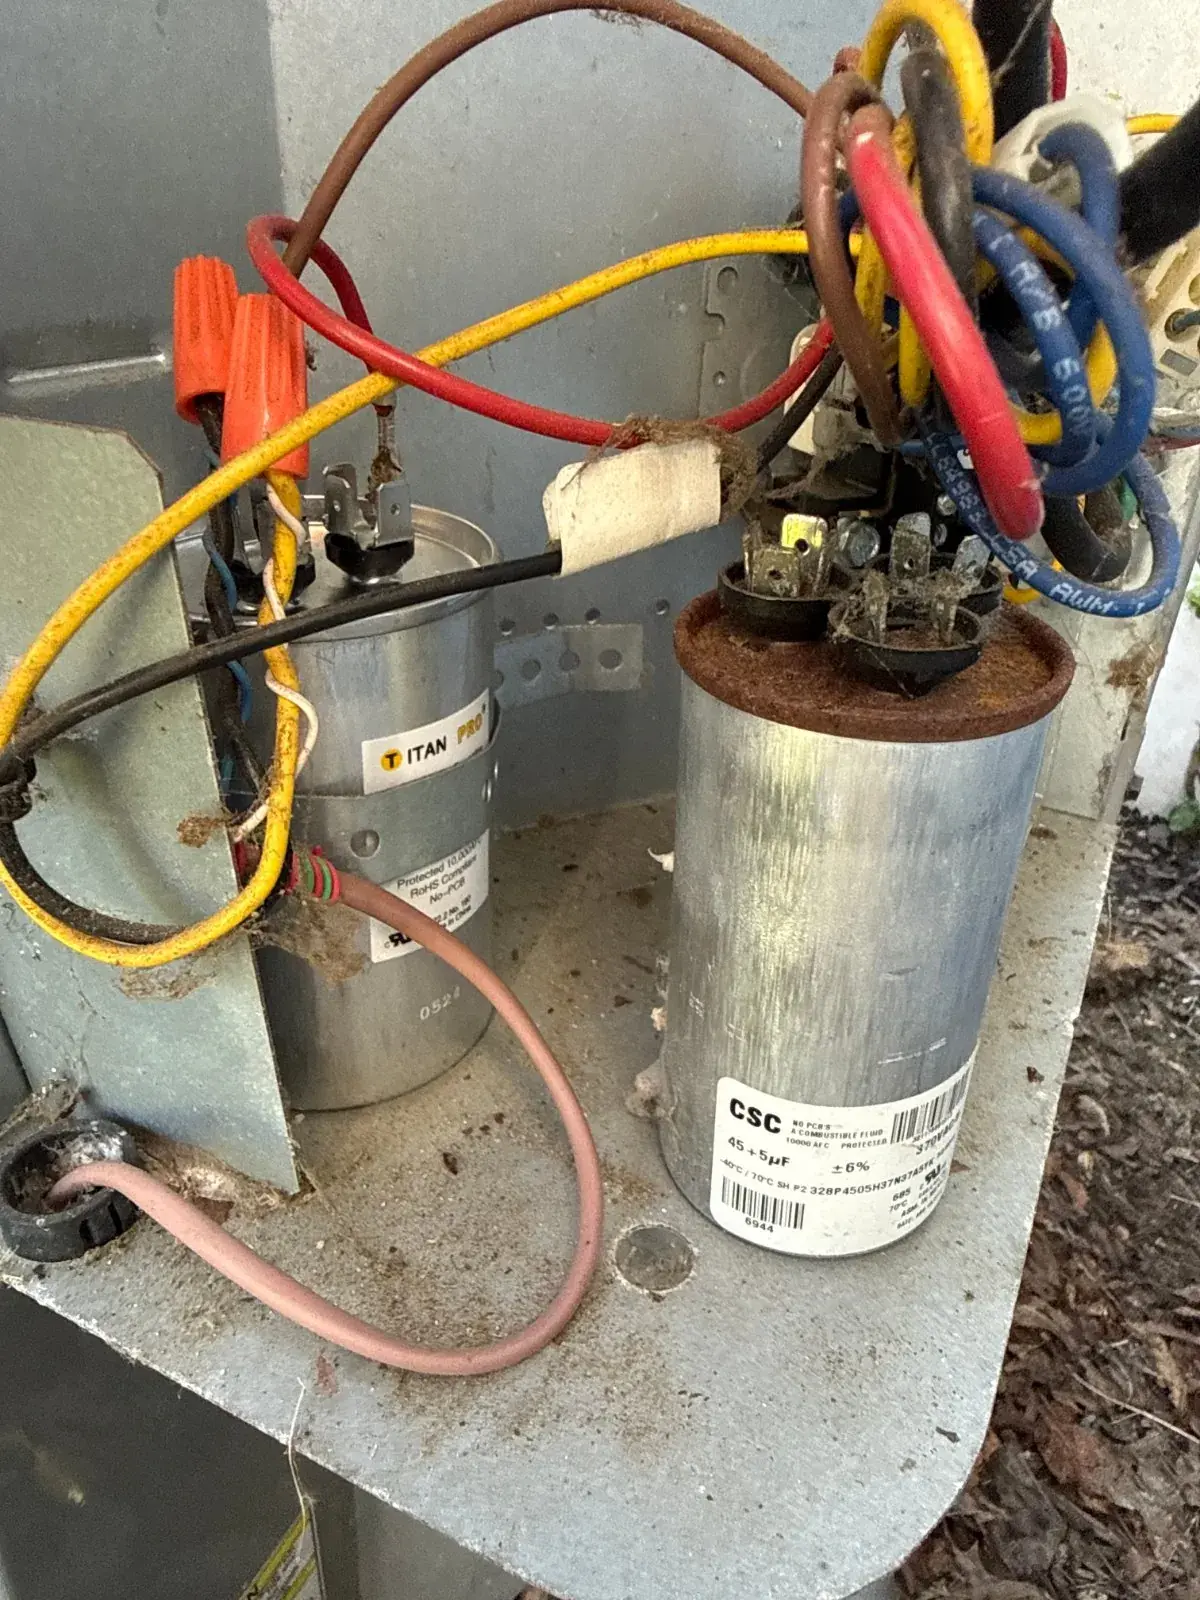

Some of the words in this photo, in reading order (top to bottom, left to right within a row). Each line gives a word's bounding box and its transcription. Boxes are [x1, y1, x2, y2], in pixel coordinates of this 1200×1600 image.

[457, 713, 484, 745] PRO
[397, 861, 445, 890] Protected
[410, 879, 439, 900] RoHS
[729, 1098, 781, 1134] CSC
[792, 1119, 804, 1128] NO
[798, 1128, 858, 1140] COMBUSTIBLE
[859, 1128, 884, 1139] FLUID
[840, 1137, 888, 1150] PROTECTED
[744, 1216, 774, 1233] 6944
